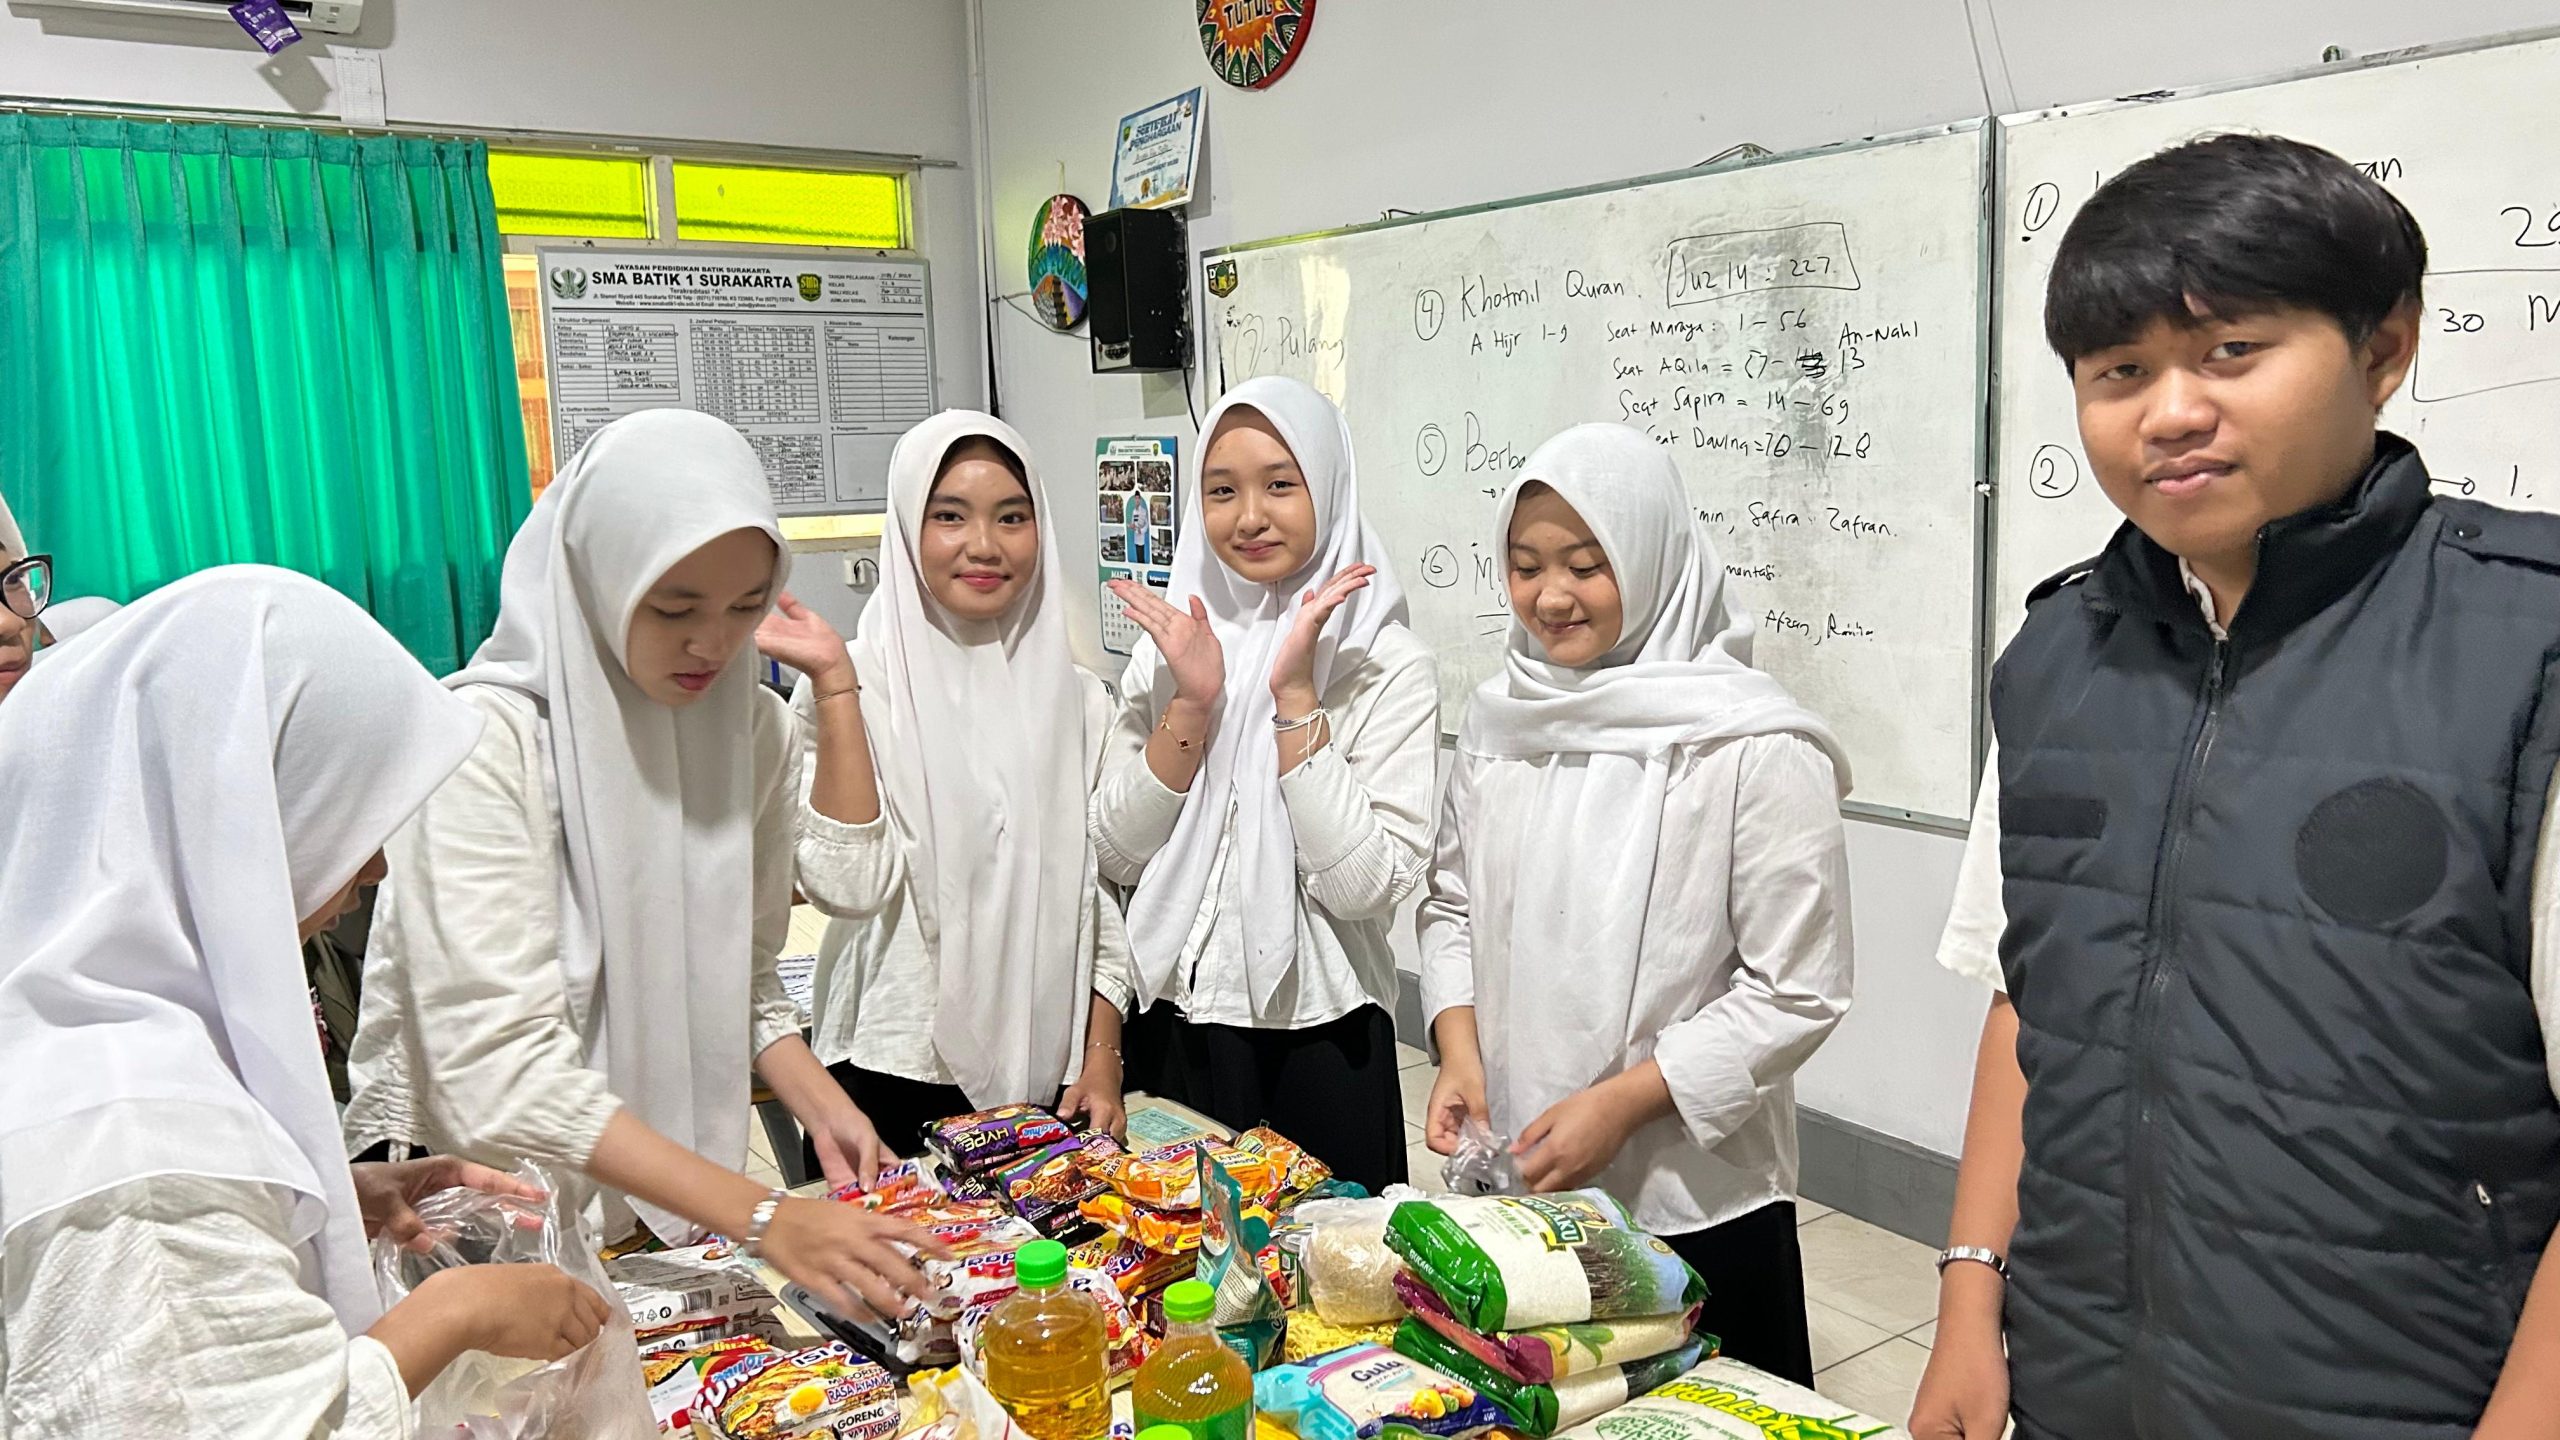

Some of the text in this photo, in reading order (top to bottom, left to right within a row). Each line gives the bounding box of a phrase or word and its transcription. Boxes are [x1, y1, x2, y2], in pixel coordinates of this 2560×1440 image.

[1130, 121, 1182, 149] PENGHARGAAN
[2354, 158, 2403, 181] an
[592, 271, 793, 288] SMA BATIK 1 SURAKARTA
[2438, 308, 2485, 333] 30
[1277, 316, 1346, 370] Pulang
[1521, 1198, 1580, 1242] GULAKU
[1350, 1358, 1405, 1383] Gula
[828, 1385, 854, 1400] RASA
[837, 1407, 884, 1430] GORENG
